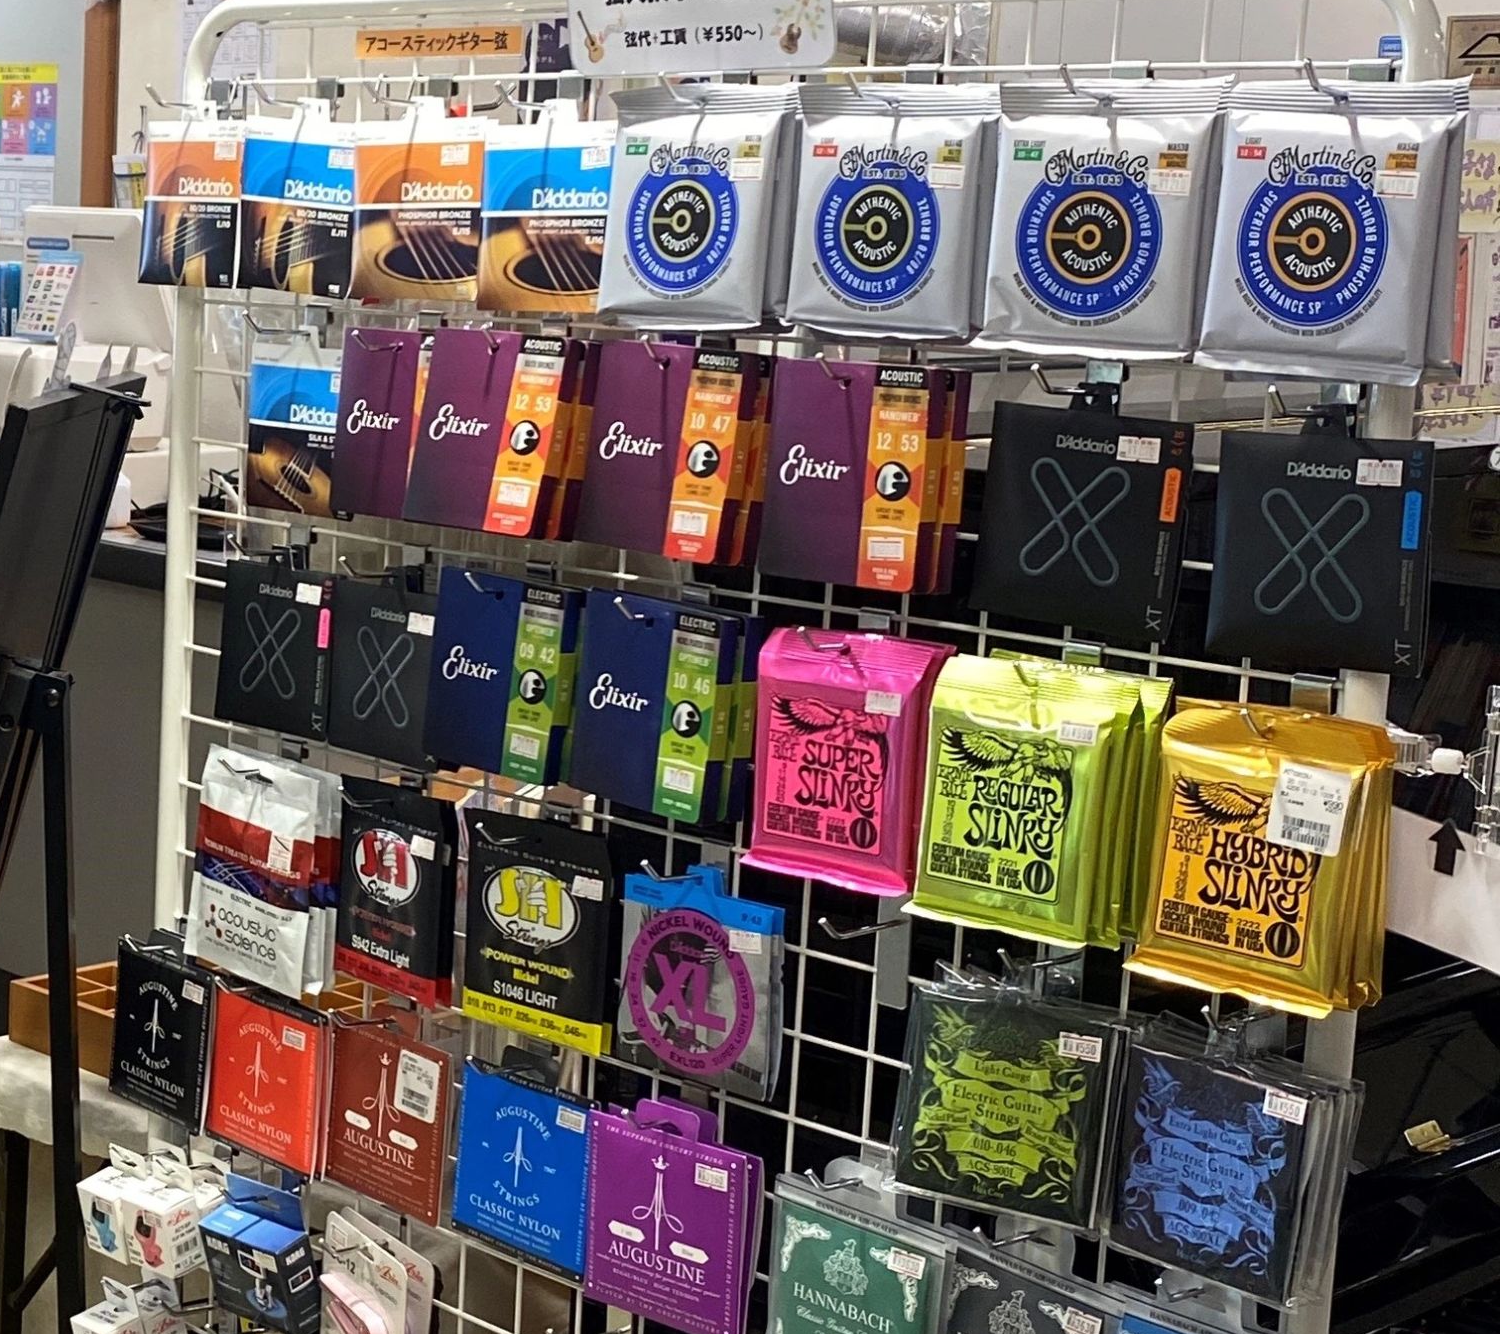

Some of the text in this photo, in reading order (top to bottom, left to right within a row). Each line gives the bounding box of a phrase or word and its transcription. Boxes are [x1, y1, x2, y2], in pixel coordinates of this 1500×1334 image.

[365, 30, 509, 53] アコースティックギター弦
[179, 177, 233, 195] D'Addario
[318, 212, 349, 222] BRONZE
[439, 210, 471, 219] BRONZE
[572, 219, 604, 227] BRONZE
[1284, 205, 1344, 278] AUTHENTIC ACOUSTIC
[524, 339, 562, 351] ACOUSTIC
[698, 353, 739, 368] ACOUSTIC
[880, 369, 923, 383] ACOUSTIC
[515, 393, 552, 412] 12 53
[690, 413, 731, 433] 10 47
[876, 433, 919, 452] 12 53
[779, 444, 849, 484] Elixir
[527, 589, 561, 603] ELECTRIC
[680, 615, 716, 632] ELECTRIC
[1145, 606, 1163, 631] XT
[442, 645, 497, 680] Elixir
[519, 642, 555, 664] 09 42
[1394, 639, 1412, 666] XT
[589, 673, 648, 712] Elixir
[673, 672, 710, 695] 10 46
[802, 739, 879, 779] SUPER
[972, 775, 1062, 820] REGULAR
[931, 842, 963, 859] CUSTOM
[931, 853, 957, 869] NICKEL
[1207, 828, 1313, 879] HYBRID
[997, 865, 1021, 881] MADE
[1198, 859, 1306, 923] SLINKY
[1162, 910, 1226, 932] NICKEL WOUND
[1163, 899, 1230, 923] CUSTOM GAUGE
[217, 907, 276, 943] acoustic
[1160, 919, 1229, 945] GUITAR STRINGS
[1236, 926, 1262, 941] MADE
[1237, 919, 1260, 929] 2222
[225, 928, 276, 961] science
[352, 934, 410, 969] S942 Extra Light
[1234, 936, 1264, 953] IN USA
[486, 948, 570, 979] POWER WOUND
[513, 969, 539, 985] Nickel
[493, 980, 557, 1010] S1046 LIGHT
[650, 953, 726, 1032] XL
[711, 970, 750, 1066] SUPER LIGHT GAUGE
[974, 1060, 1031, 1083] Light Gauge
[952, 1083, 1043, 1117] Electric Guitar
[219, 1105, 292, 1145] CLASSIC NYLON
[975, 1103, 1020, 1126] Strings
[343, 1128, 414, 1169] AUGUSTINE
[622, 1128, 657, 1146] SUPERIOR
[659, 1139, 693, 1158] CONCERT
[696, 1150, 723, 1165] STRING
[493, 1180, 540, 1207] STRINGS
[469, 1193, 561, 1241] CLASSIC NYLON
[608, 1239, 706, 1286] AUGUSTINE
[793, 1282, 891, 1334] HANNABACH
[796, 1306, 825, 1326] Classic
